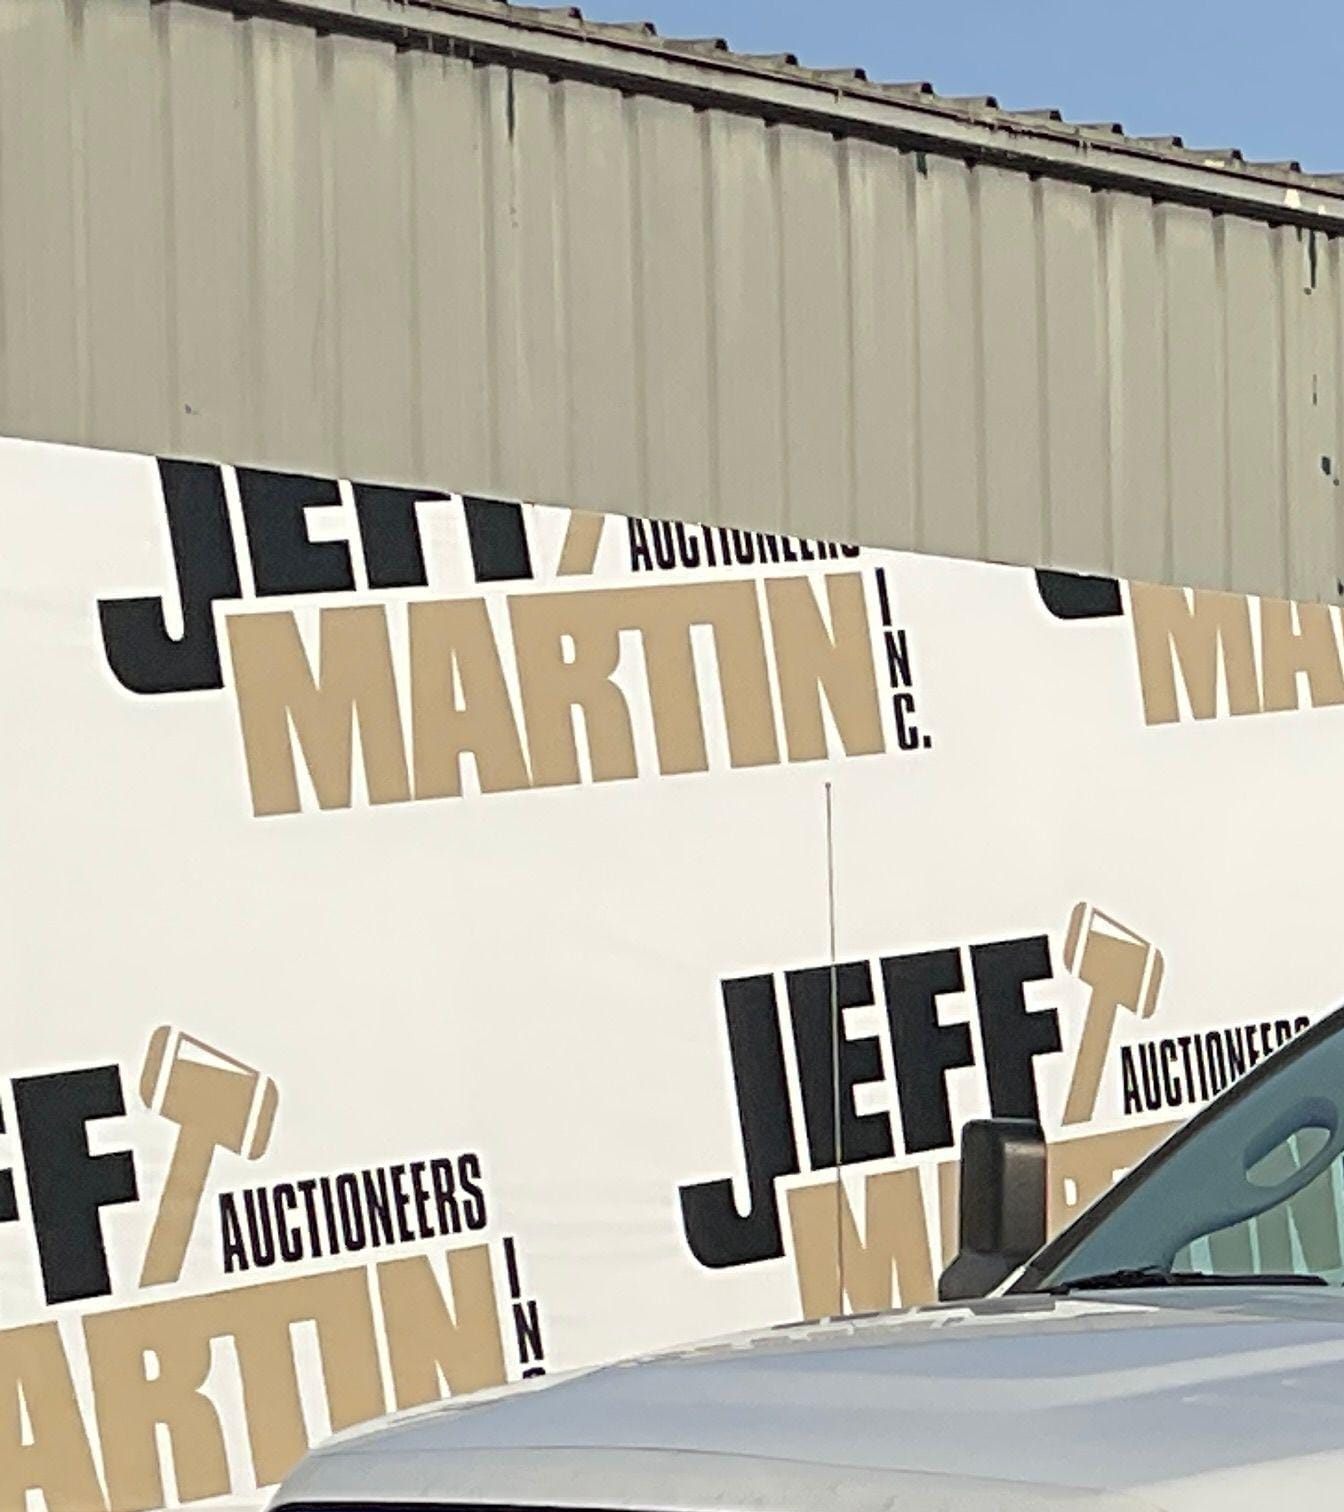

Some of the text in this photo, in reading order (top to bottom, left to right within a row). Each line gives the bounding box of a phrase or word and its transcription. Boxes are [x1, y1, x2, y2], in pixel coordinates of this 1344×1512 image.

[226, 572, 885, 817] MARTIN
[876, 567, 932, 750] INC.
[678, 935, 1063, 1268] JEFF
[218, 1152, 488, 1274] AUCTIONEERS
